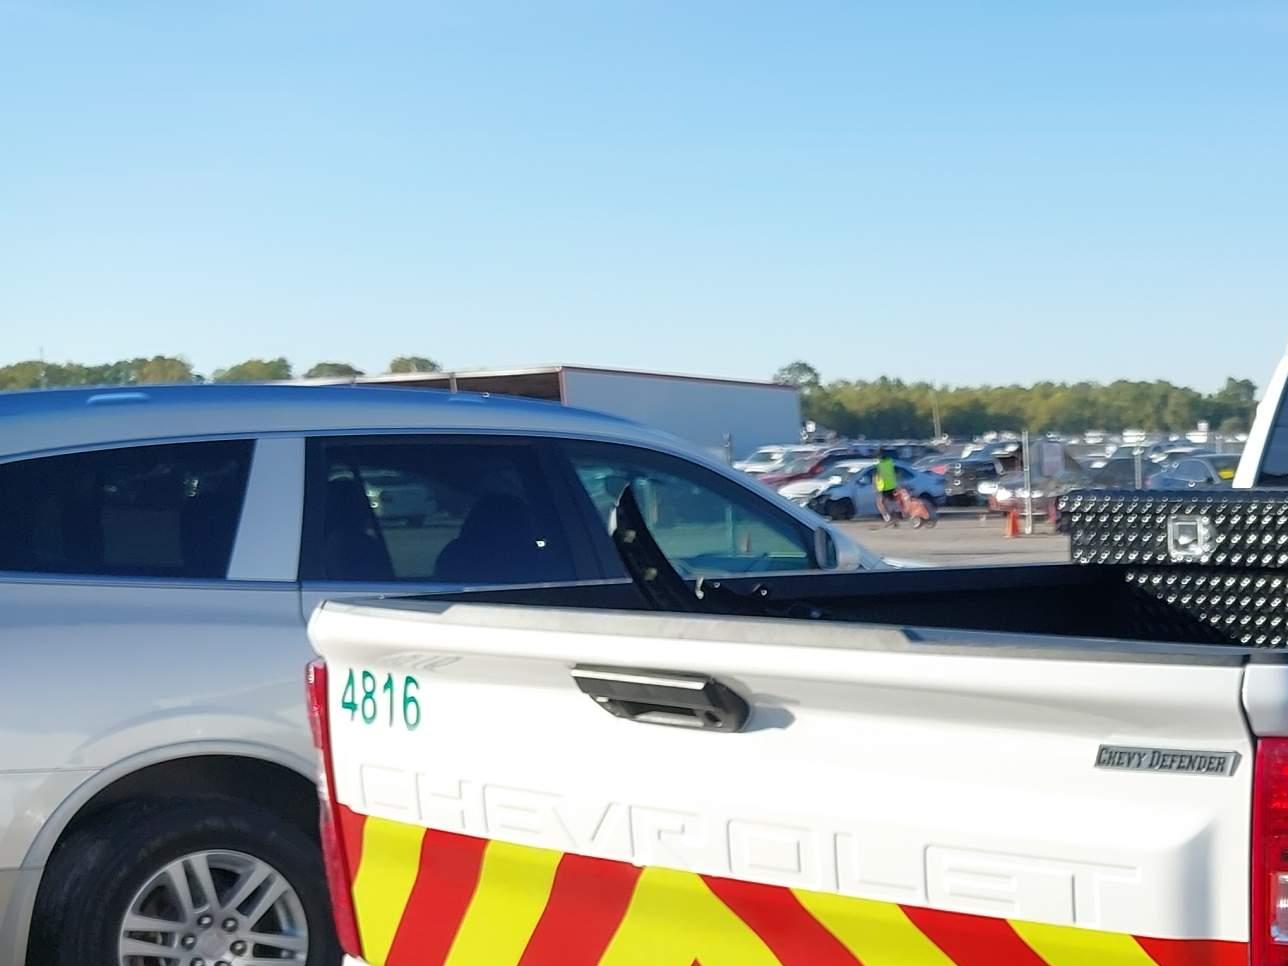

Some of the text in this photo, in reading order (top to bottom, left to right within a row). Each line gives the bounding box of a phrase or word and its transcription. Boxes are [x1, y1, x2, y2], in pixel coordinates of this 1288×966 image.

[341, 667, 421, 731] 4816
[1097, 747, 1227, 773] CHEVY DEFENDER
[359, 762, 1142, 924] CHEVROLET
